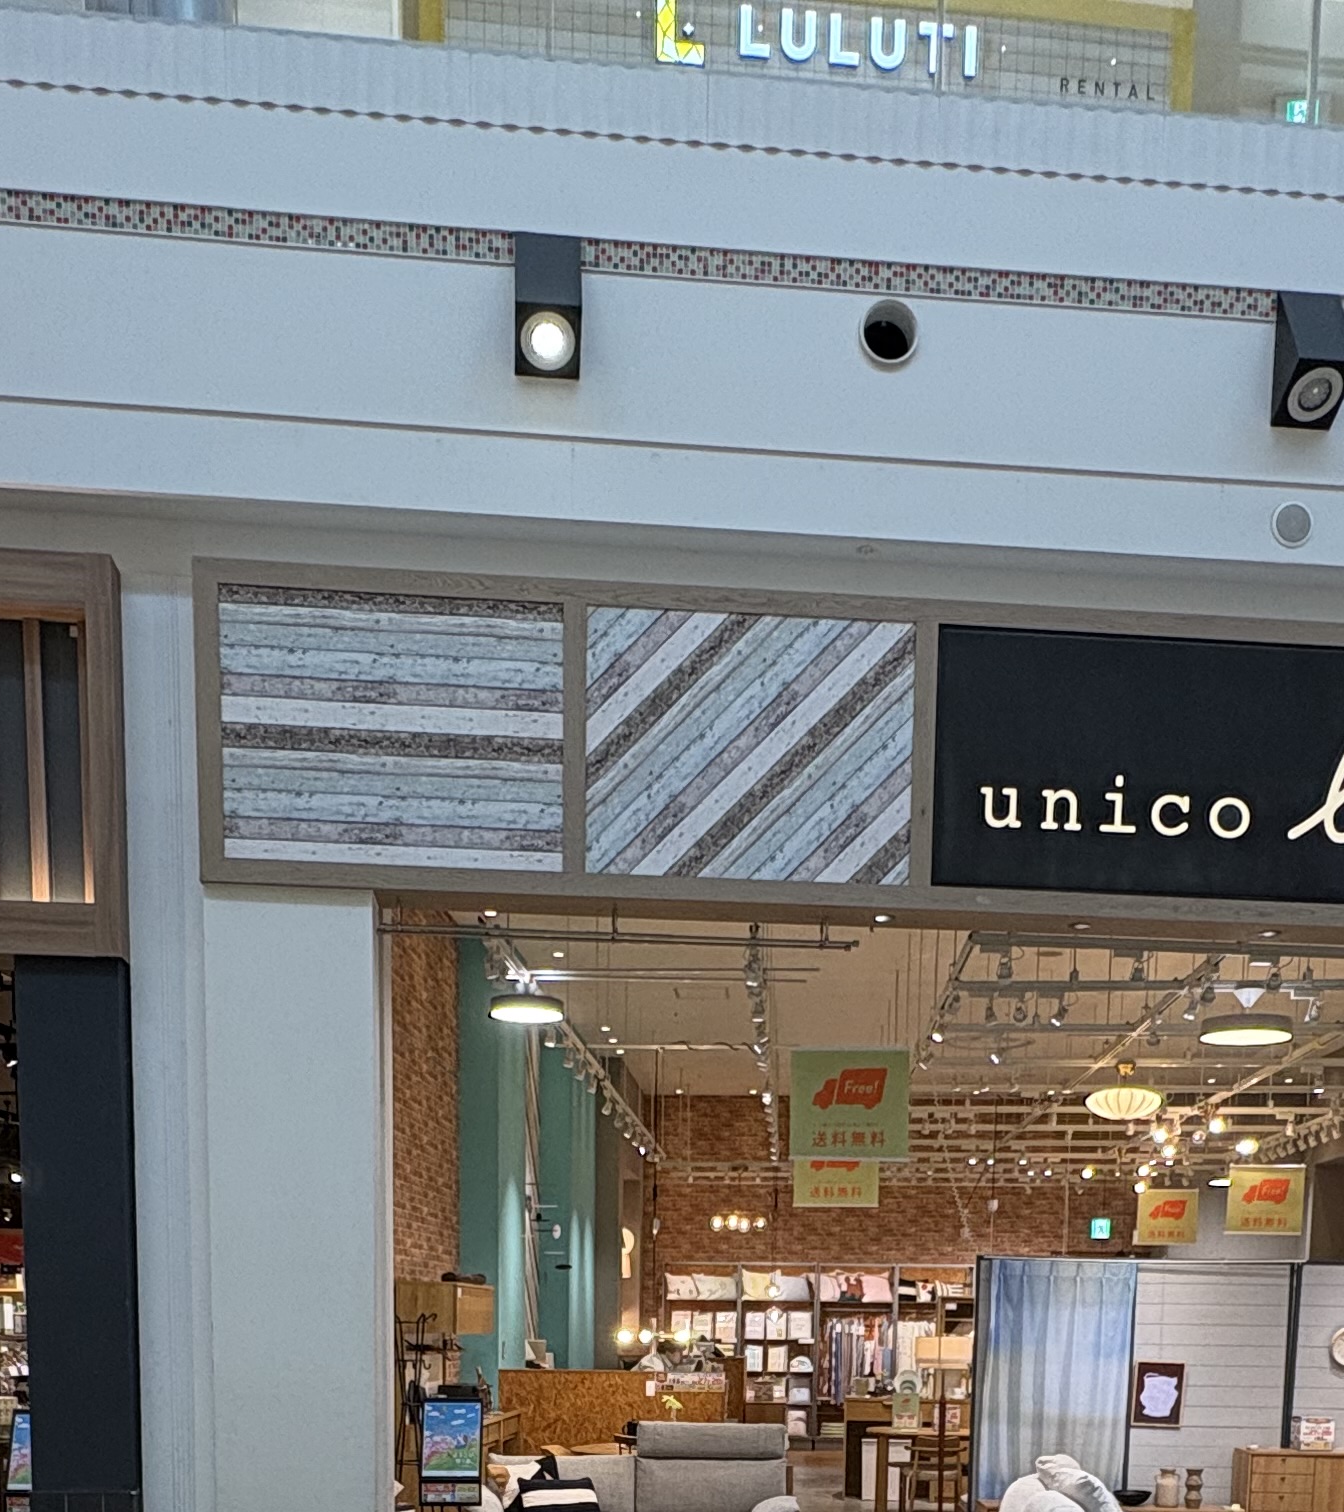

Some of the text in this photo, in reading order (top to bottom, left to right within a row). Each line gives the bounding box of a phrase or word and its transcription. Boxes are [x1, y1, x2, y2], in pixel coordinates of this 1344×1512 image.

[738, 4, 979, 79] LULUTI
[1059, 77, 1156, 101] RENTAL
[979, 774, 1252, 840] unico
[844, 1079, 878, 1095] Free!
[812, 1130, 886, 1148] 送料無料
